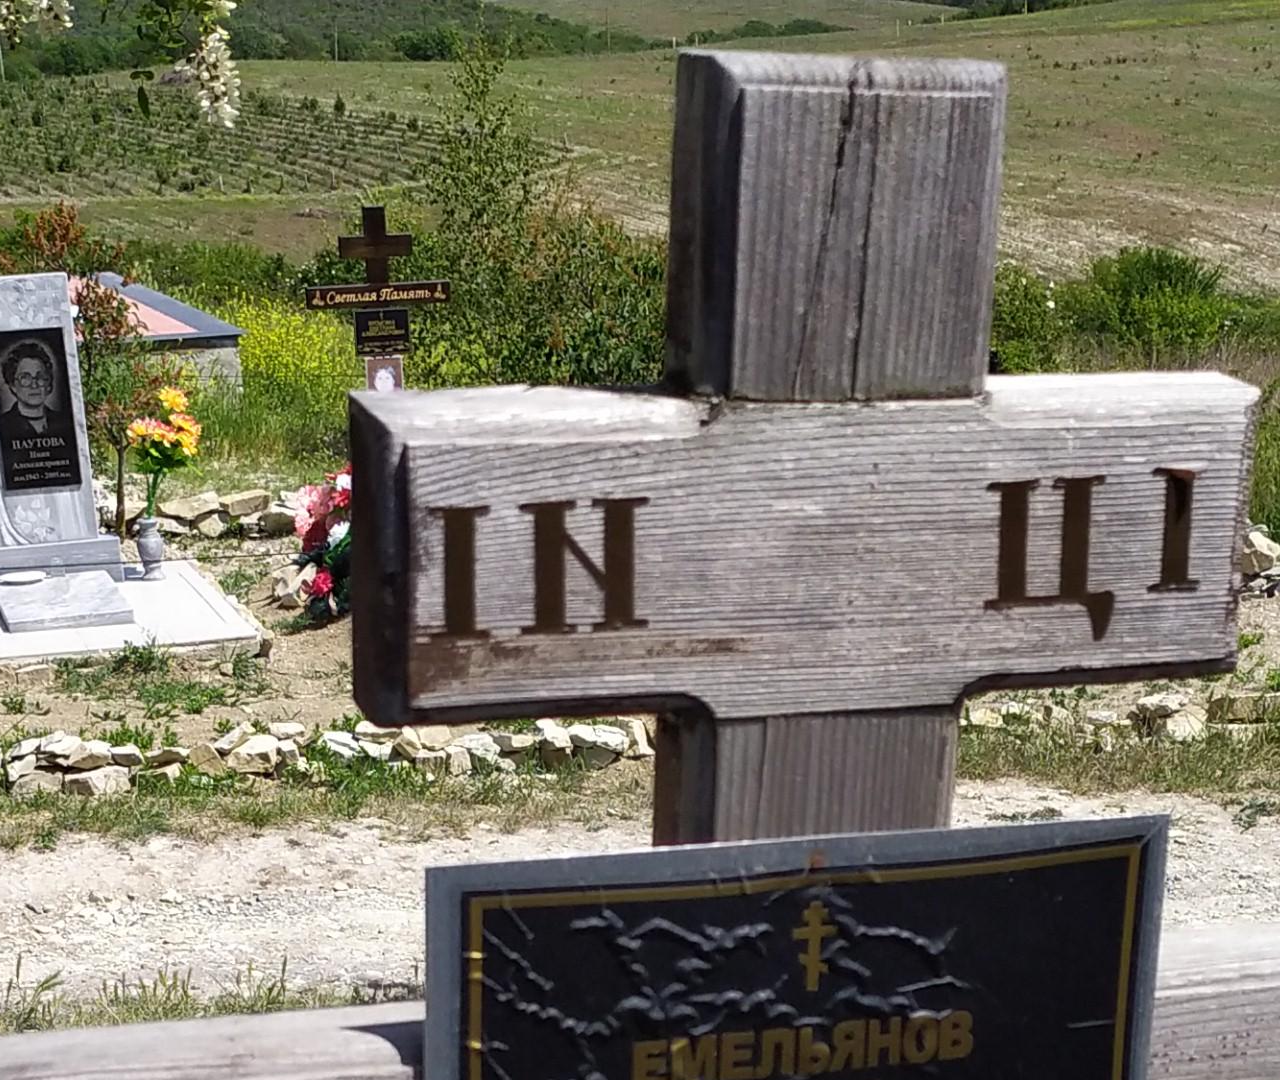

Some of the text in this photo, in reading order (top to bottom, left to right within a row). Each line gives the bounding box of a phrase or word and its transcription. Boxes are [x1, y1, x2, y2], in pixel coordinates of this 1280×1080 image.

[326, 287, 431, 305] Светлая Память
[12, 437, 65, 449] ПАУТОВА
